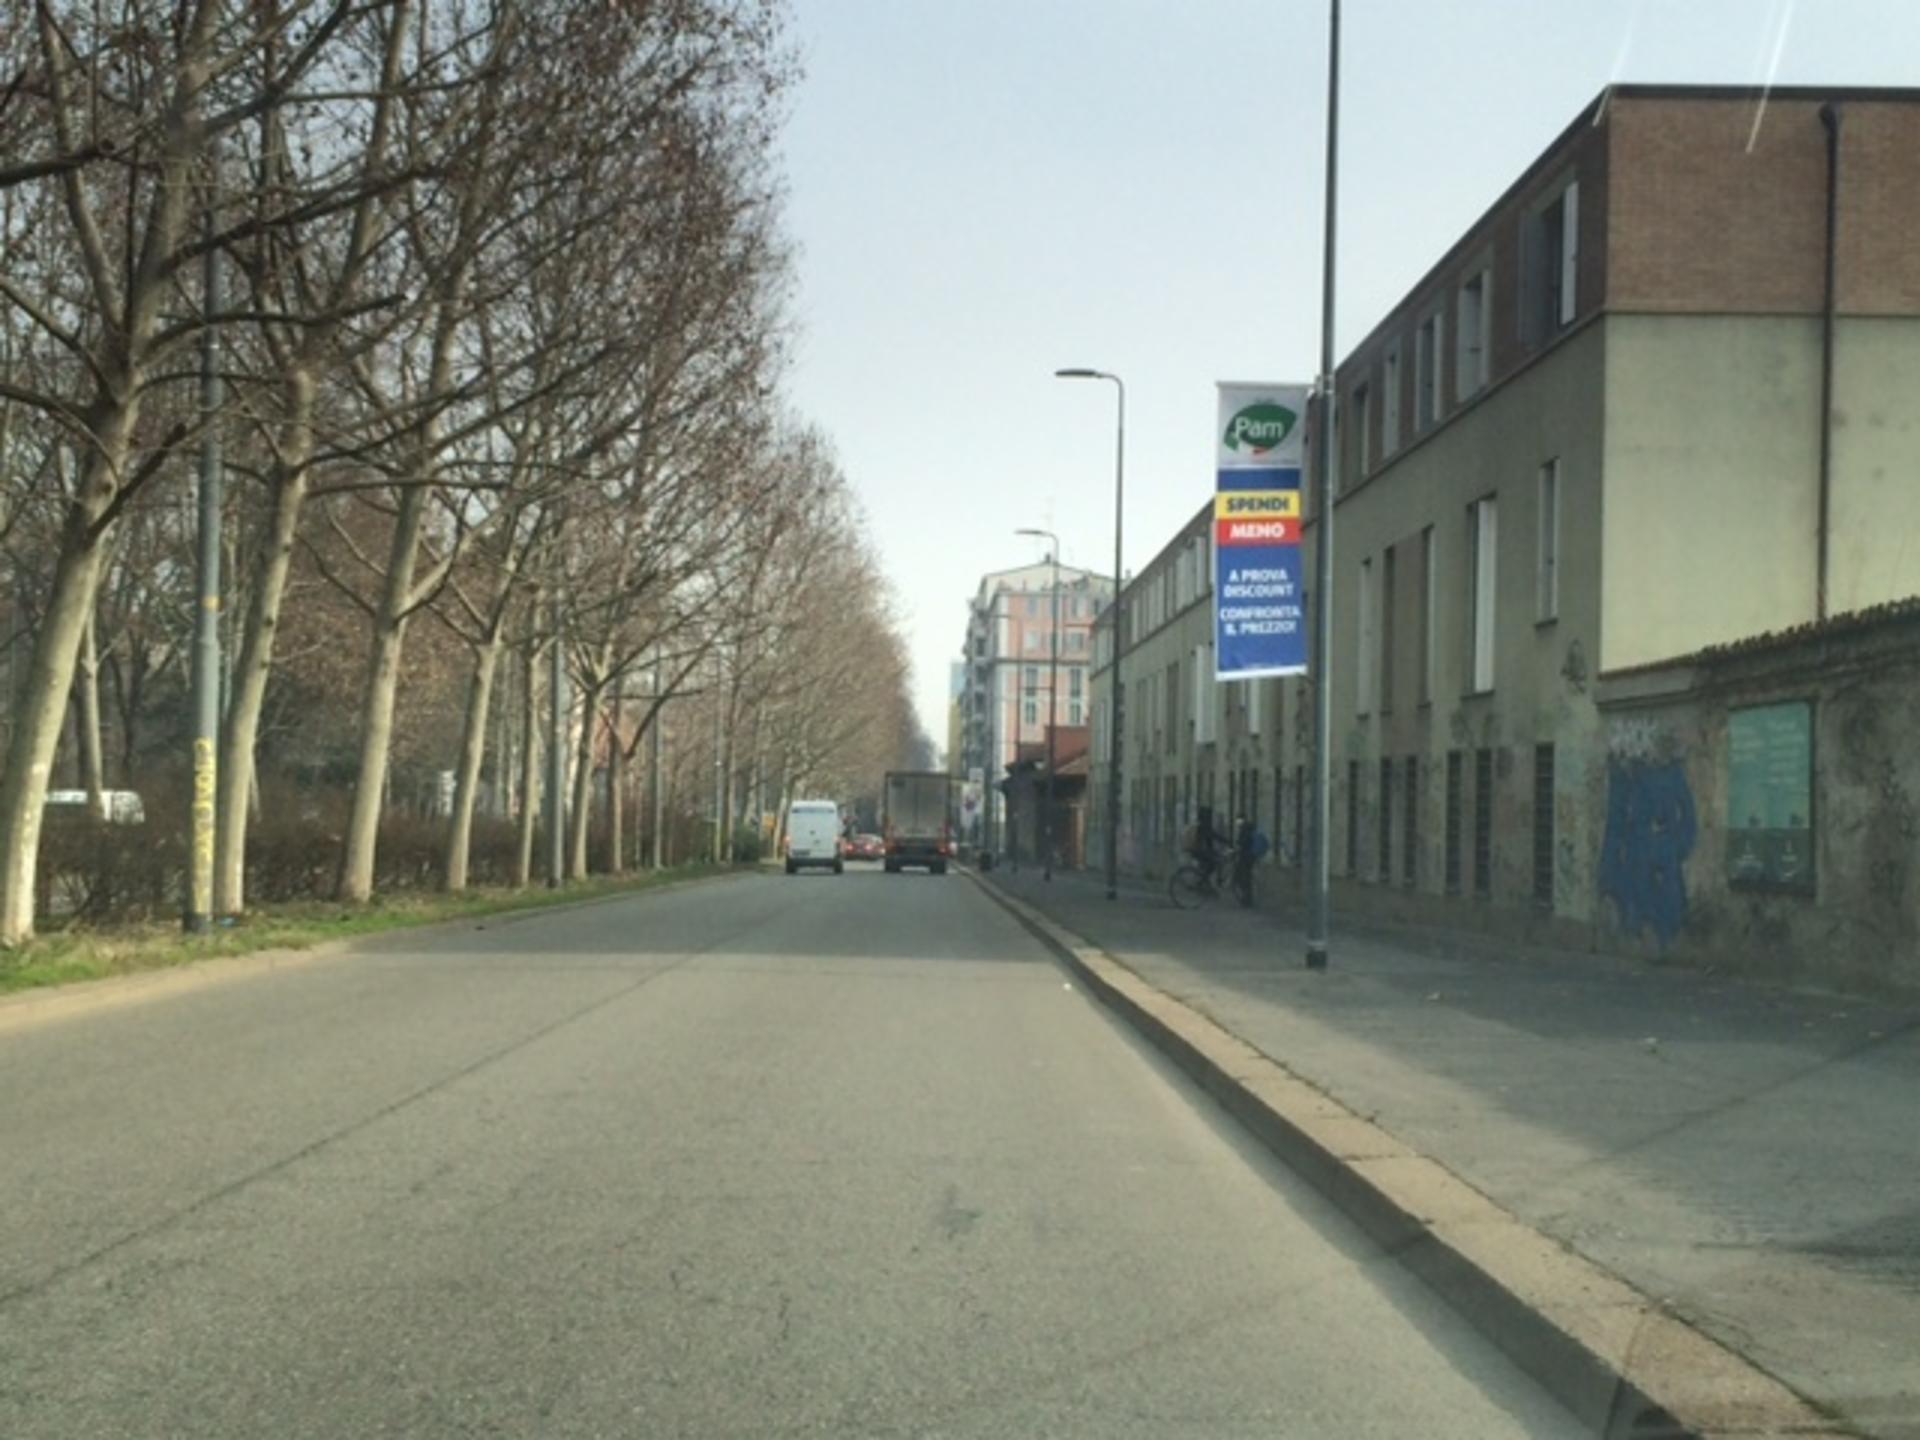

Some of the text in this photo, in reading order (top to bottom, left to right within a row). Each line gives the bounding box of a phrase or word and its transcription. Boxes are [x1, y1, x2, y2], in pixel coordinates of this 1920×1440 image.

[1227, 497, 1290, 512] SPENDI
[1230, 523, 1285, 538] MENO
[1229, 569, 1288, 582] A PROVA
